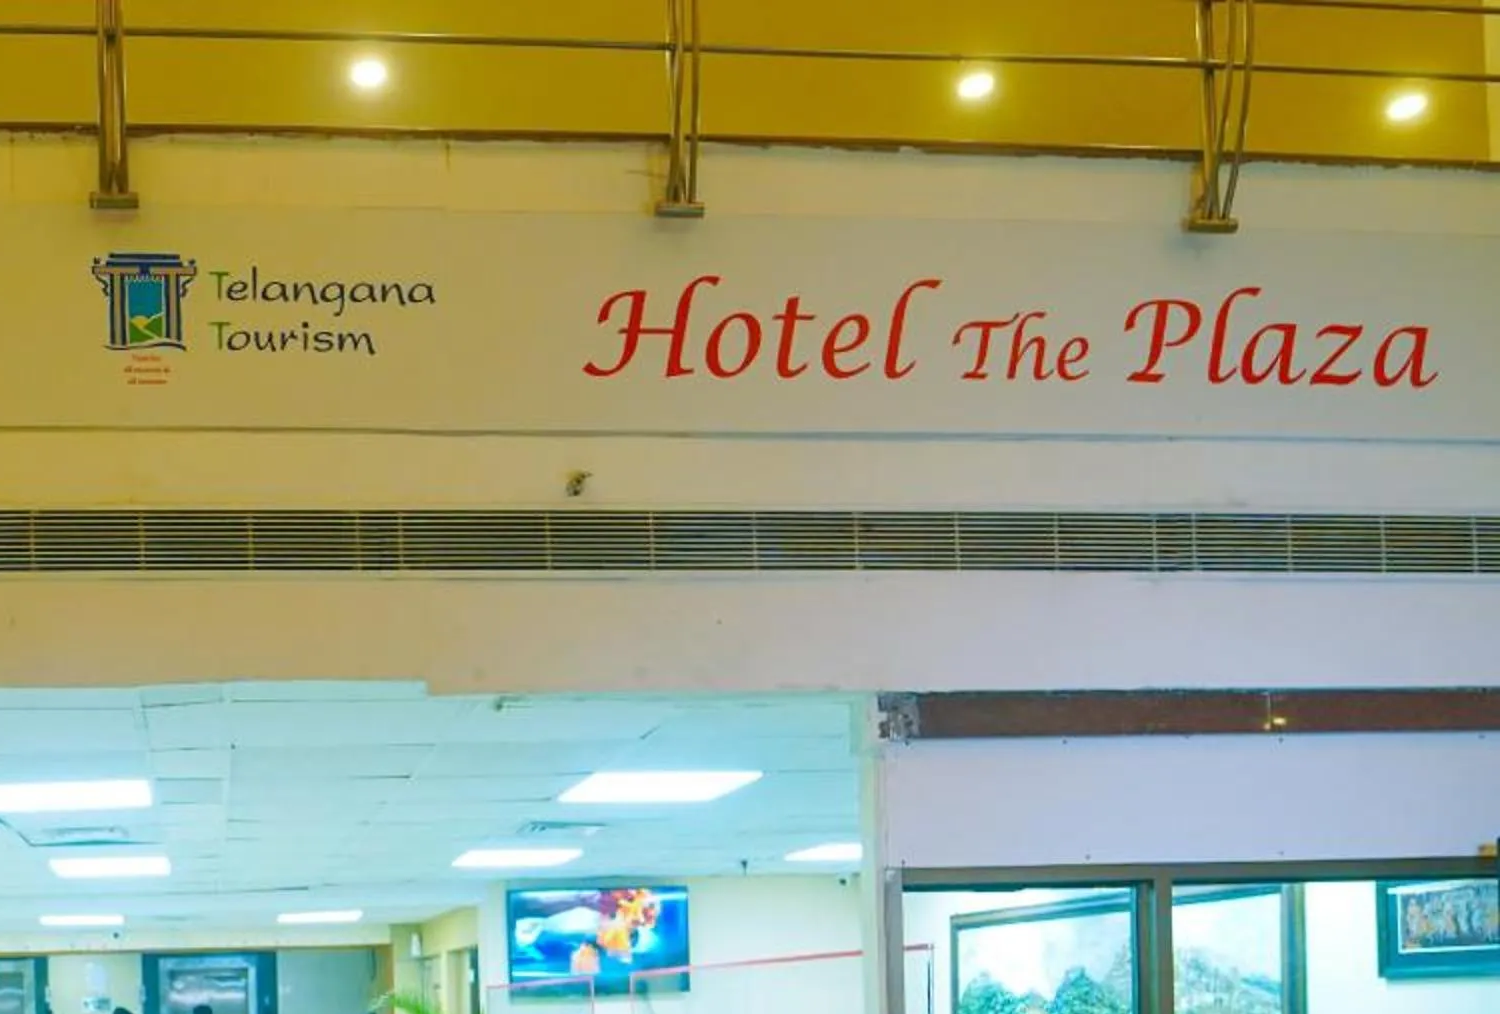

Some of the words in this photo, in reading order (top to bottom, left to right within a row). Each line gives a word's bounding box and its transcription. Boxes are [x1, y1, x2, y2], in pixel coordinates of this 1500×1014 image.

[208, 266, 436, 316] Telangana
[208, 321, 376, 356] Tourism
[582, 275, 942, 382] Hotel
[952, 311, 1089, 382] The
[1125, 286, 1439, 389] Plaza
